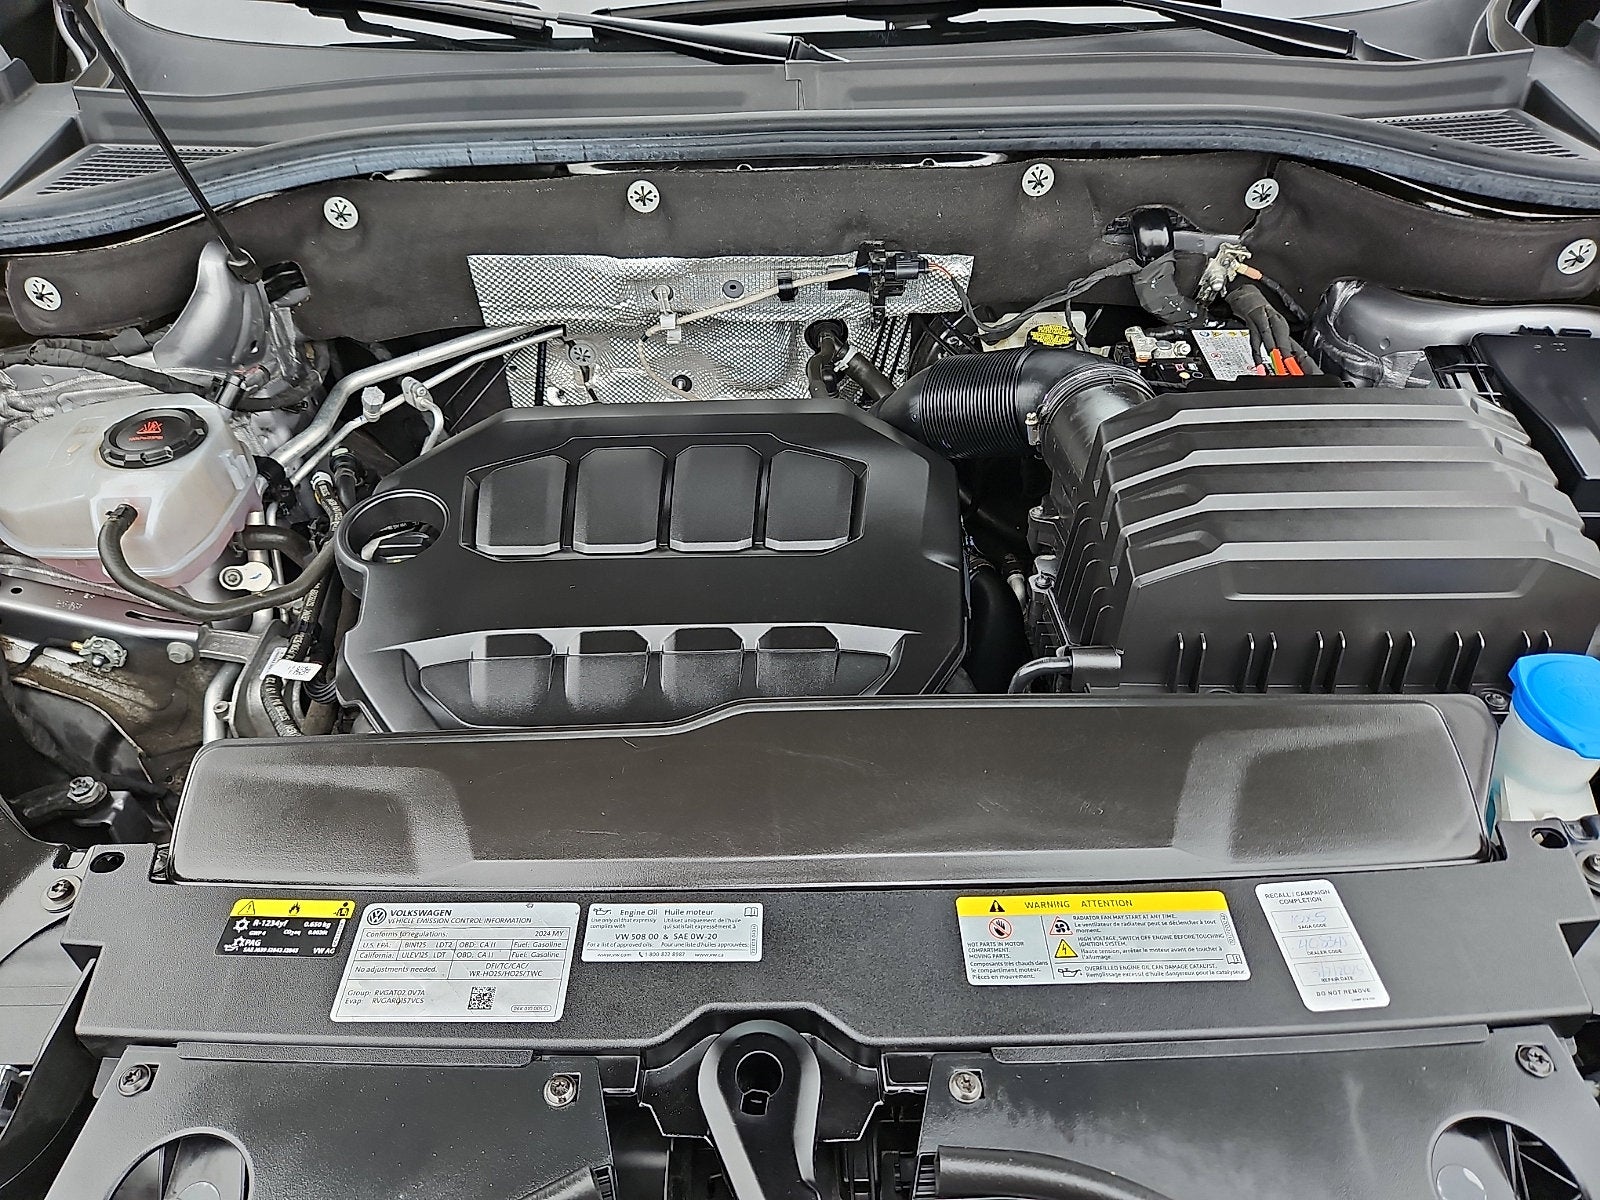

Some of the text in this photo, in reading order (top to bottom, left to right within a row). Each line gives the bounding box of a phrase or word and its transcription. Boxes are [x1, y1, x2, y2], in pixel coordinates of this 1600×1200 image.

[1024, 901, 1070, 909] WARNING
[620, 909, 645, 917] Engine
[253, 920, 289, 928] R-1234yf
[366, 966, 409, 974] adjustments
